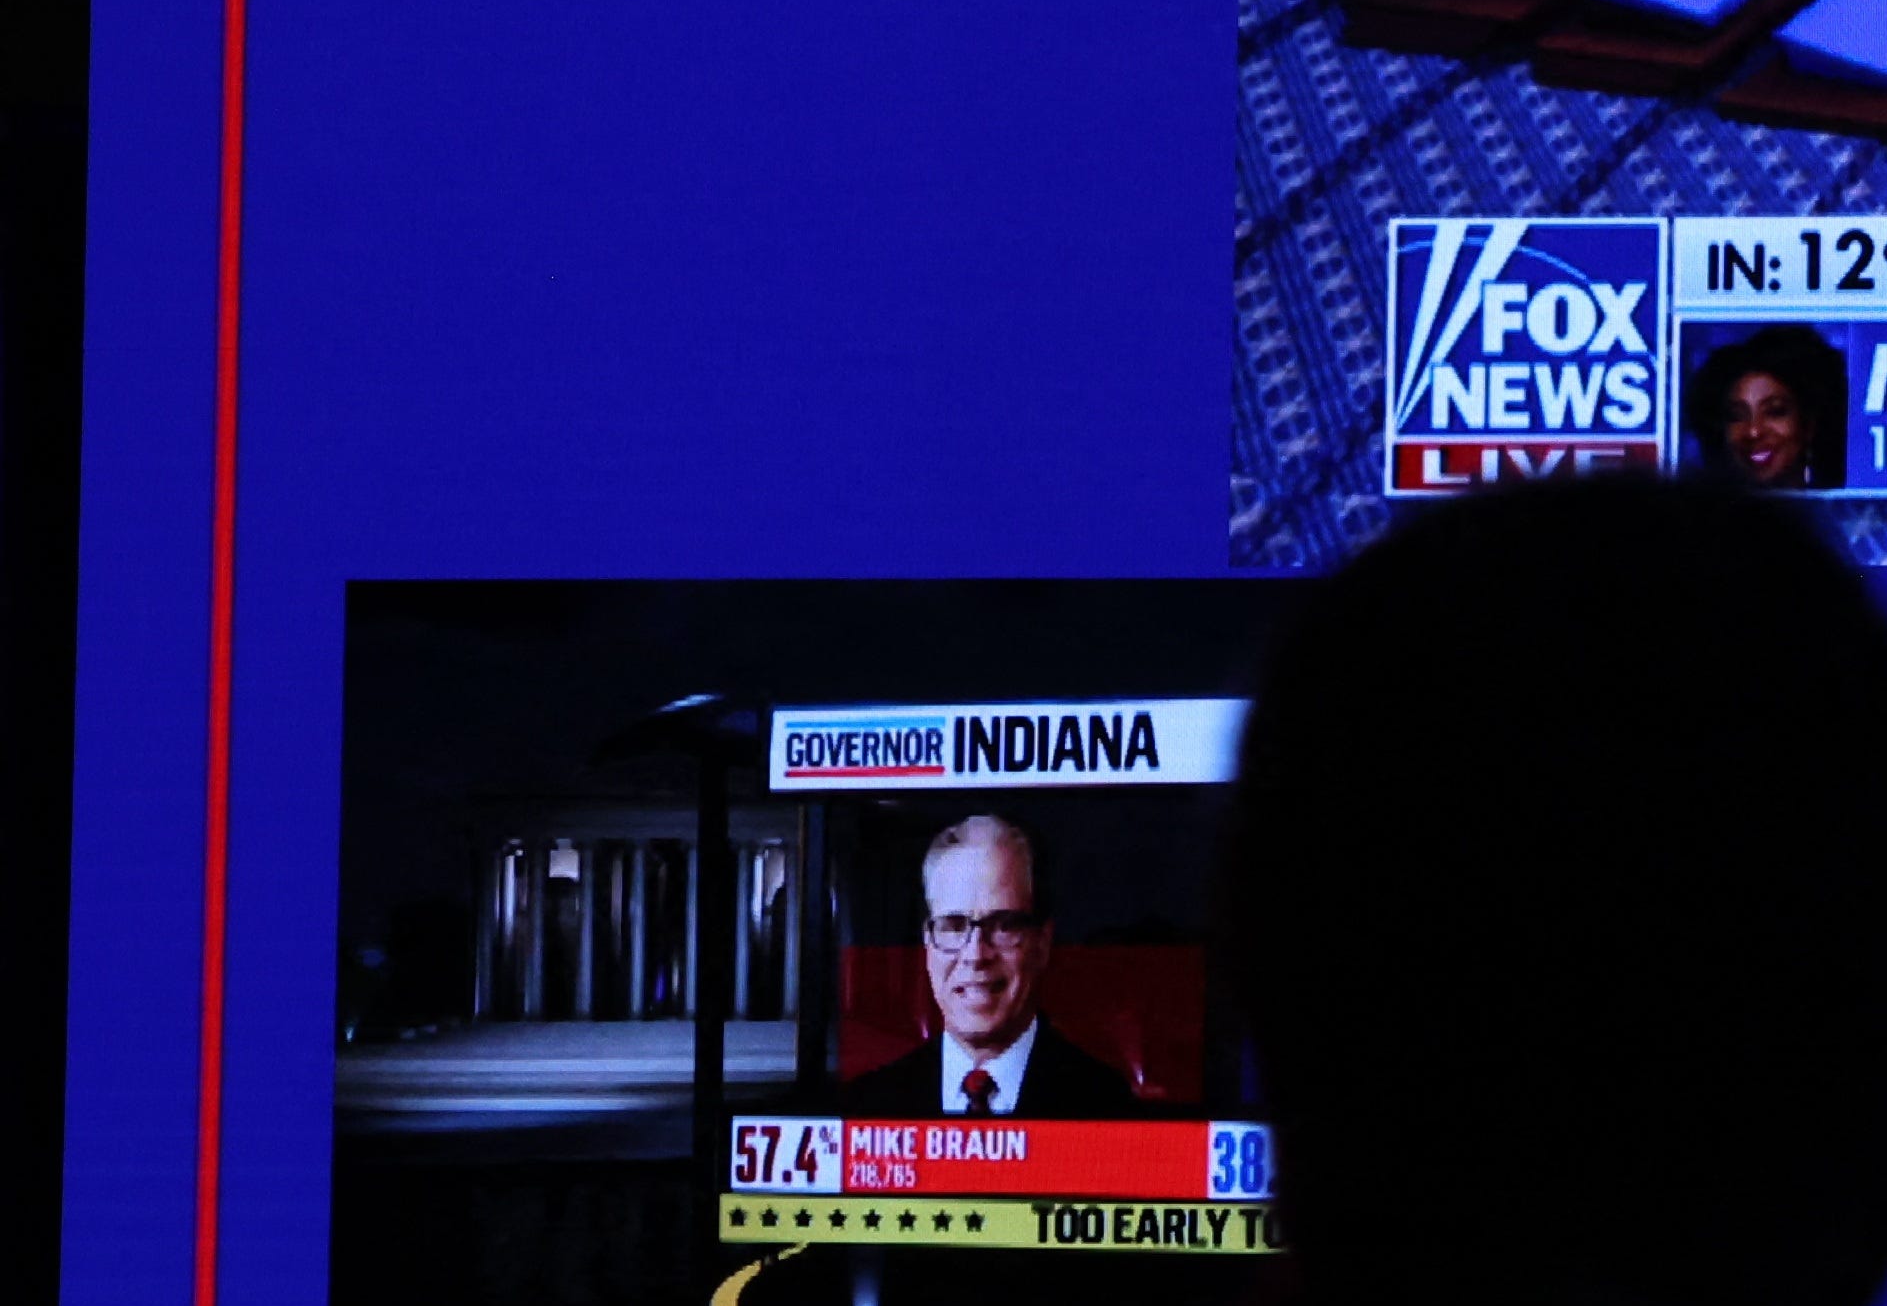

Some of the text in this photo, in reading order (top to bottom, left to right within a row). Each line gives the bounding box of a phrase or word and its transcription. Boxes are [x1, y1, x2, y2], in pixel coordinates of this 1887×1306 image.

[1707, 243, 1784, 290] IN:
[1482, 282, 1647, 355] FOX
[1429, 366, 1652, 430] NEWS
[785, 711, 1160, 772] GOVERNOR INDIANA
[851, 1126, 1027, 1160] MIKE BRAUN
[1033, 1204, 1105, 1244] TOO
[1113, 1207, 1229, 1248] EARLY
